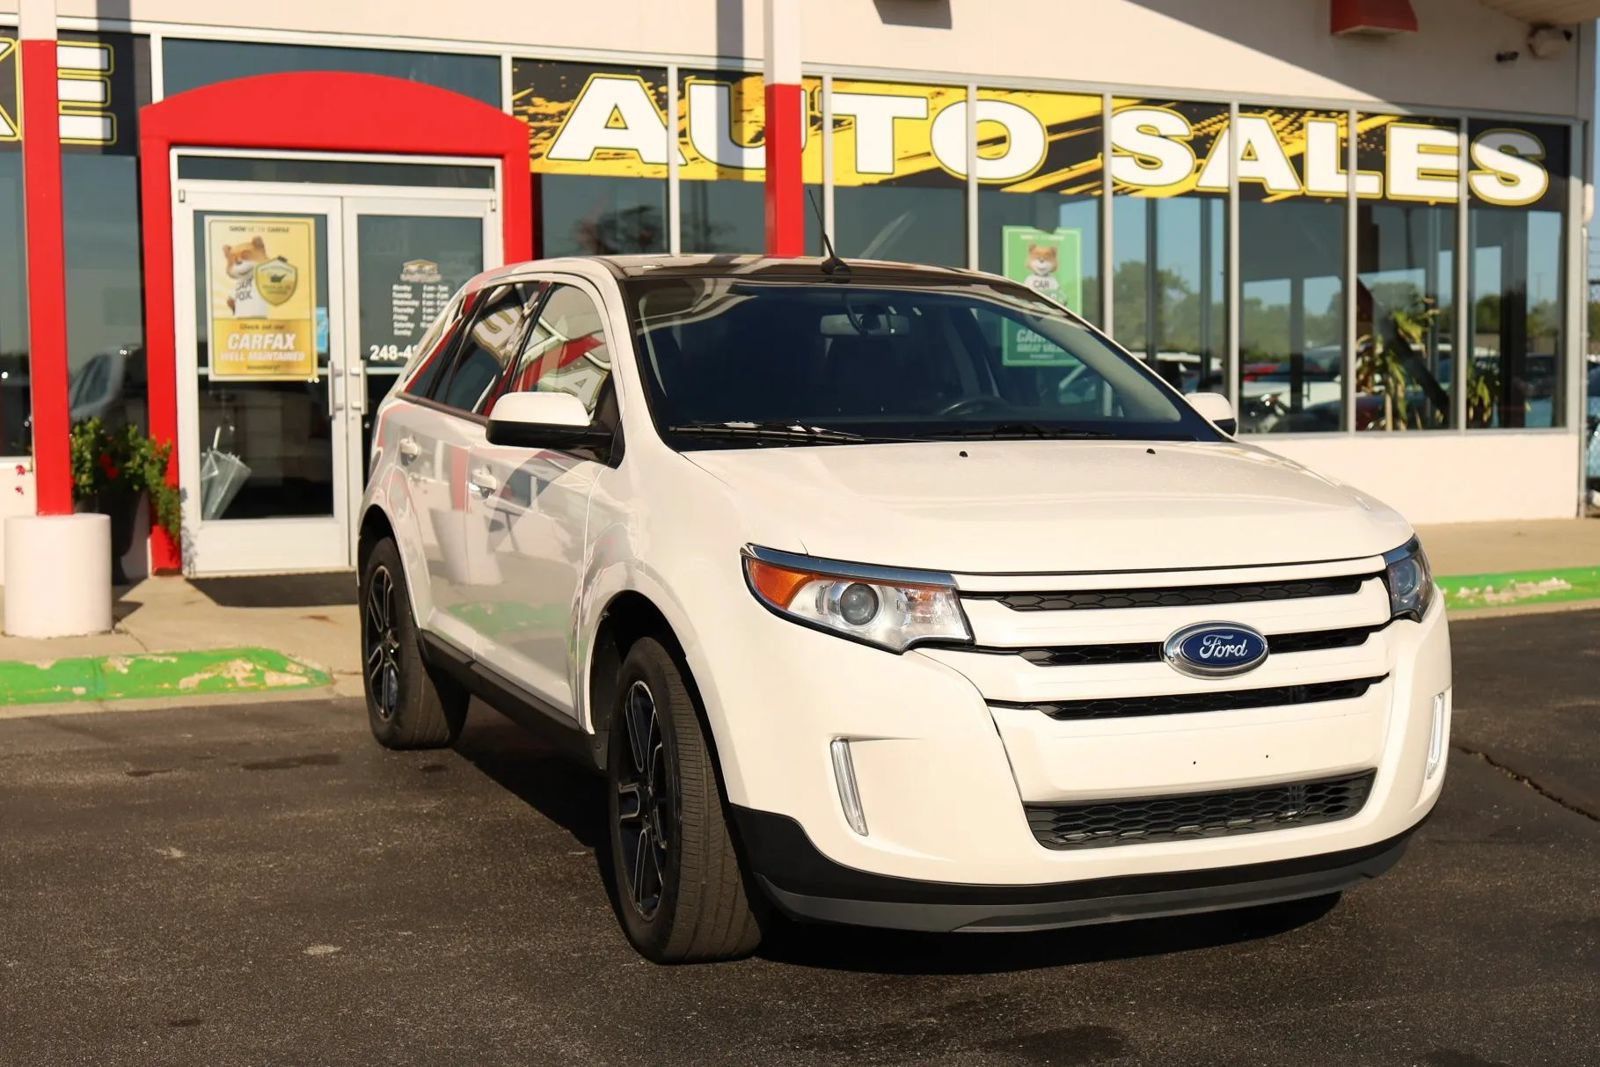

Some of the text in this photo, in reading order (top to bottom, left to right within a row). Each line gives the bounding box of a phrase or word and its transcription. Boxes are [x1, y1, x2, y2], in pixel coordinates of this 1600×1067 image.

[546, 73, 1549, 206] AUTO SALES
[229, 333, 296, 350] CARFAX
[369, 344, 418, 361] 248-4
[1199, 634, 1249, 659] Ford
